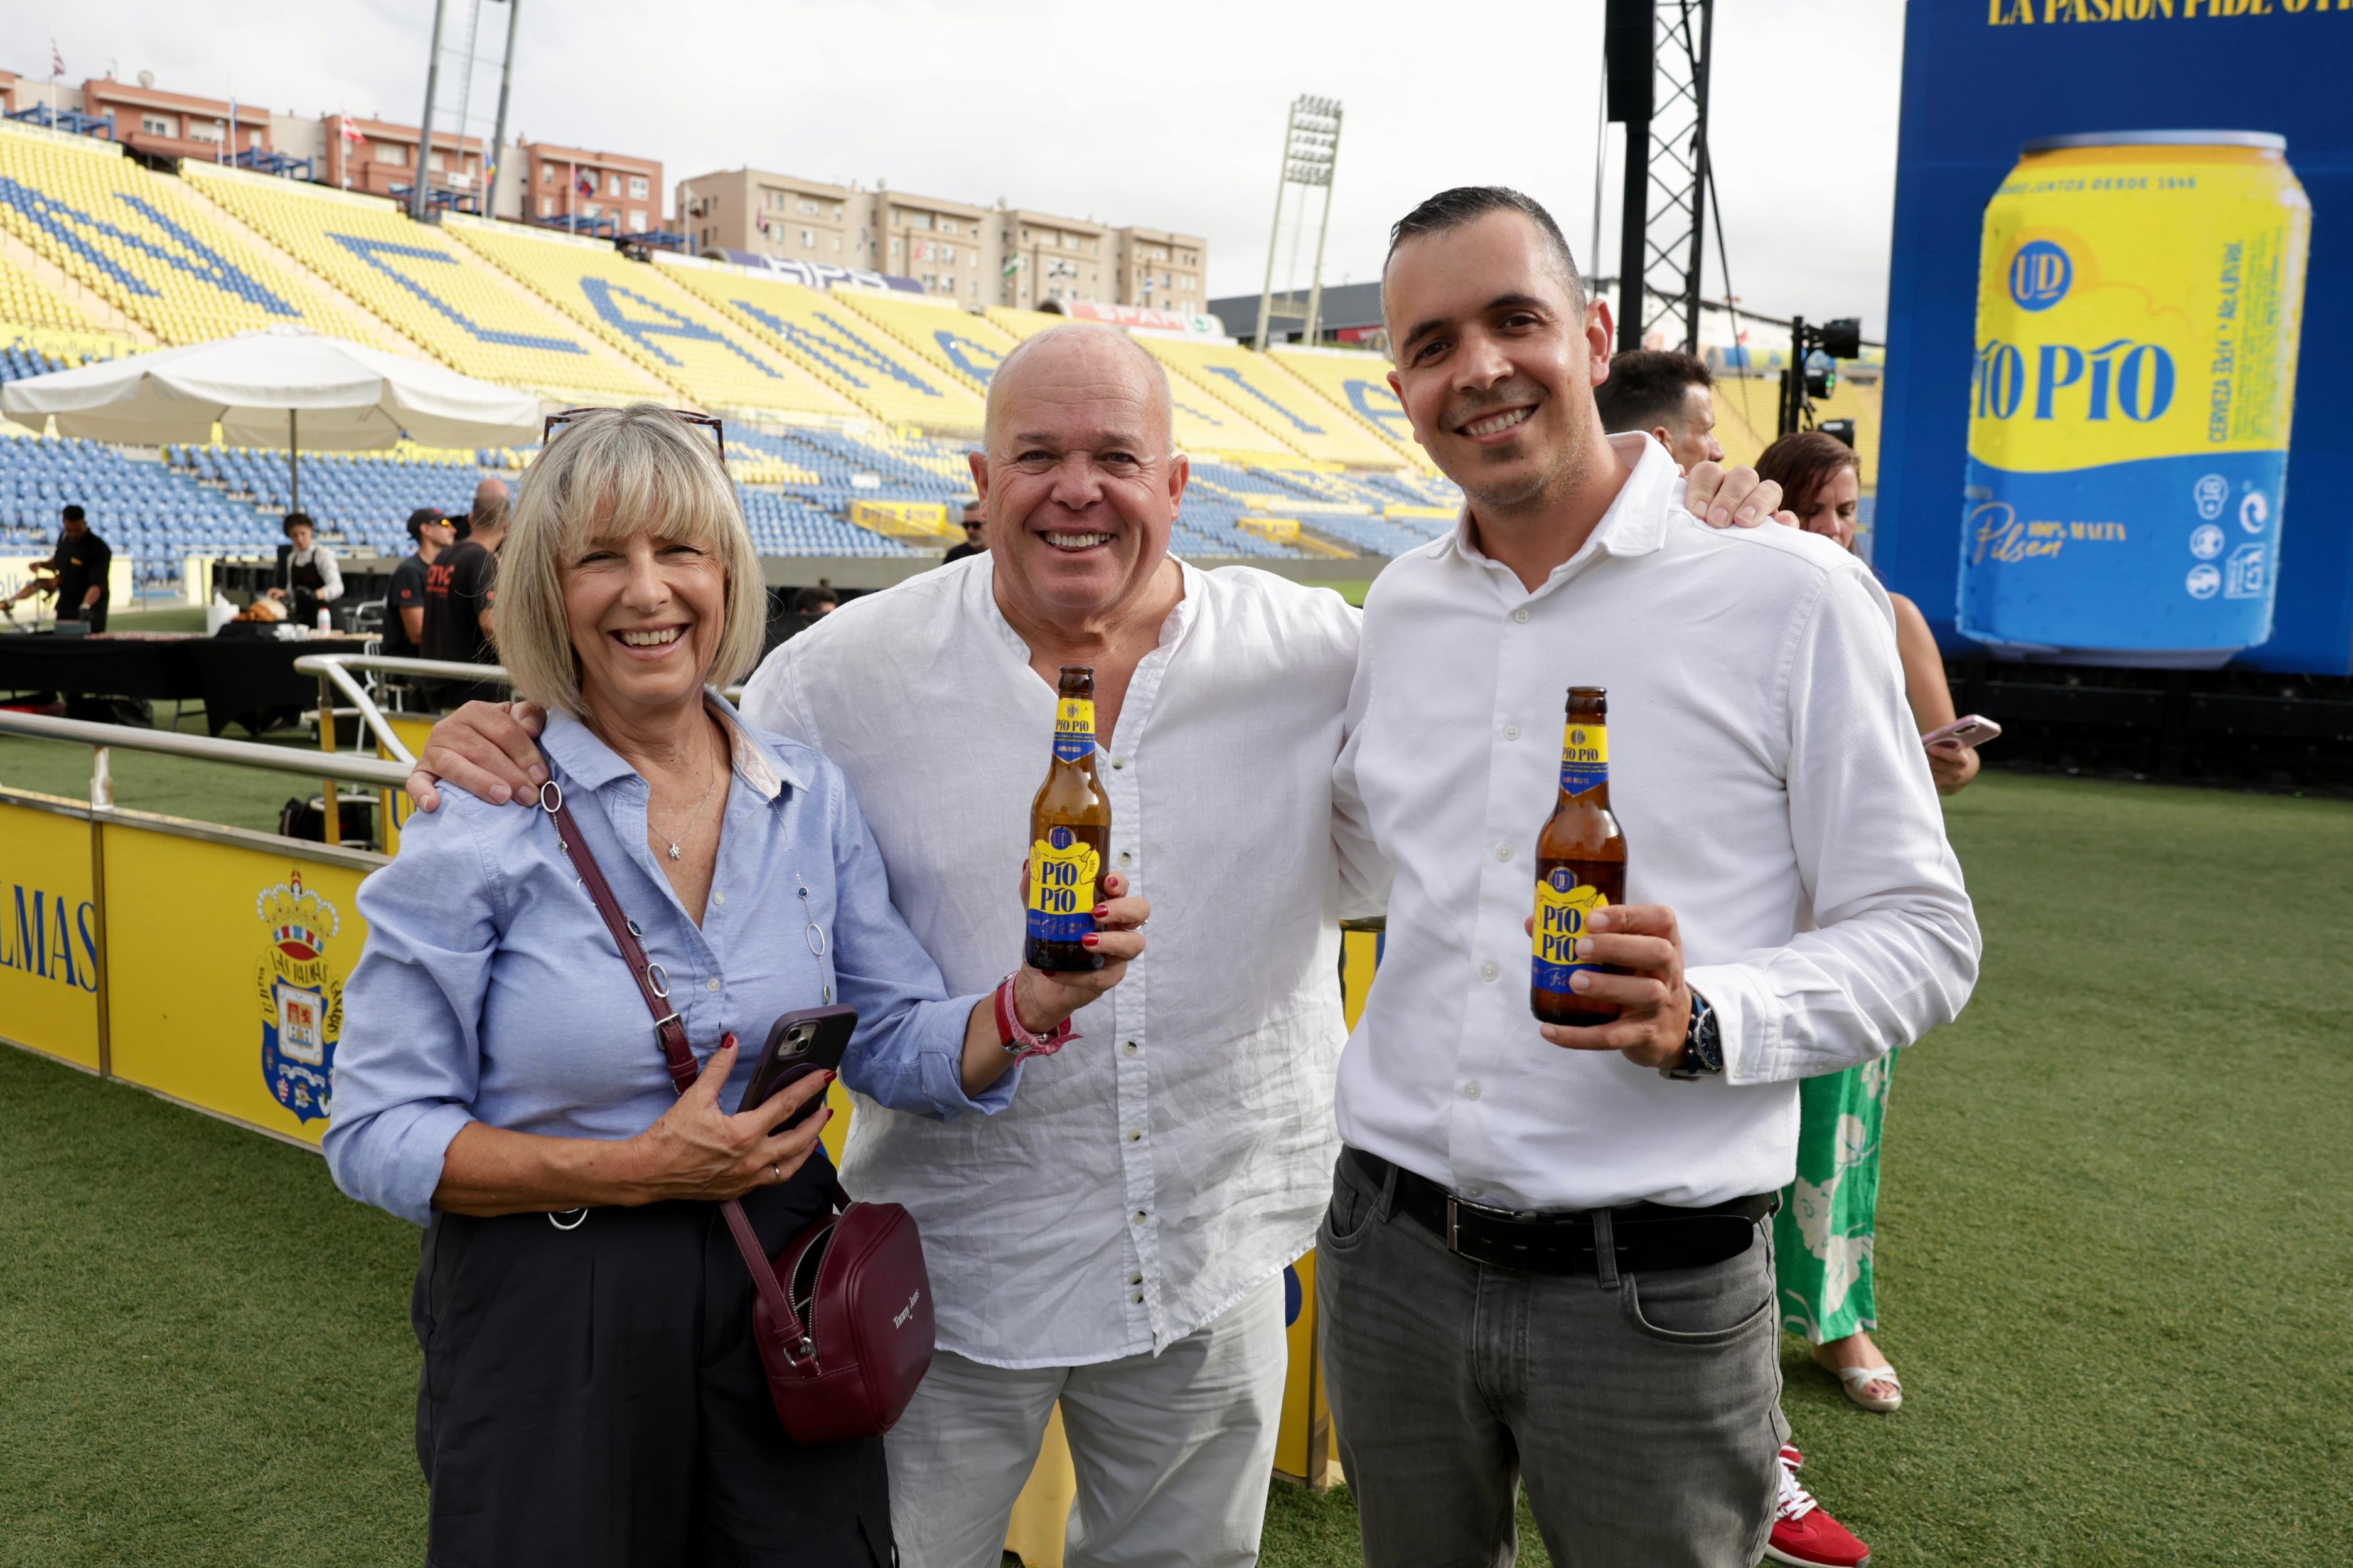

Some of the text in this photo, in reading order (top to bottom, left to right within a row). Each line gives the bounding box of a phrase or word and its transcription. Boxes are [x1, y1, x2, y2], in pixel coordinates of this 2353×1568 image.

[2013, 253, 2064, 300] UD
[1973, 339, 2025, 420] ÍO
[2033, 339, 2177, 422] PÍO
[2208, 378, 2231, 443] CERVEZA
[1968, 501, 2062, 565] Pilsen
[1042, 861, 1078, 886] PÍO
[1041, 887, 1076, 913] PÍO
[1543, 905, 1582, 934] PÍO
[1542, 933, 1579, 963] PÍO
[271, 951, 289, 975] LAS
[293, 961, 328, 984] PALMAS
[893, 1289, 919, 1330] Tommy Jeans
